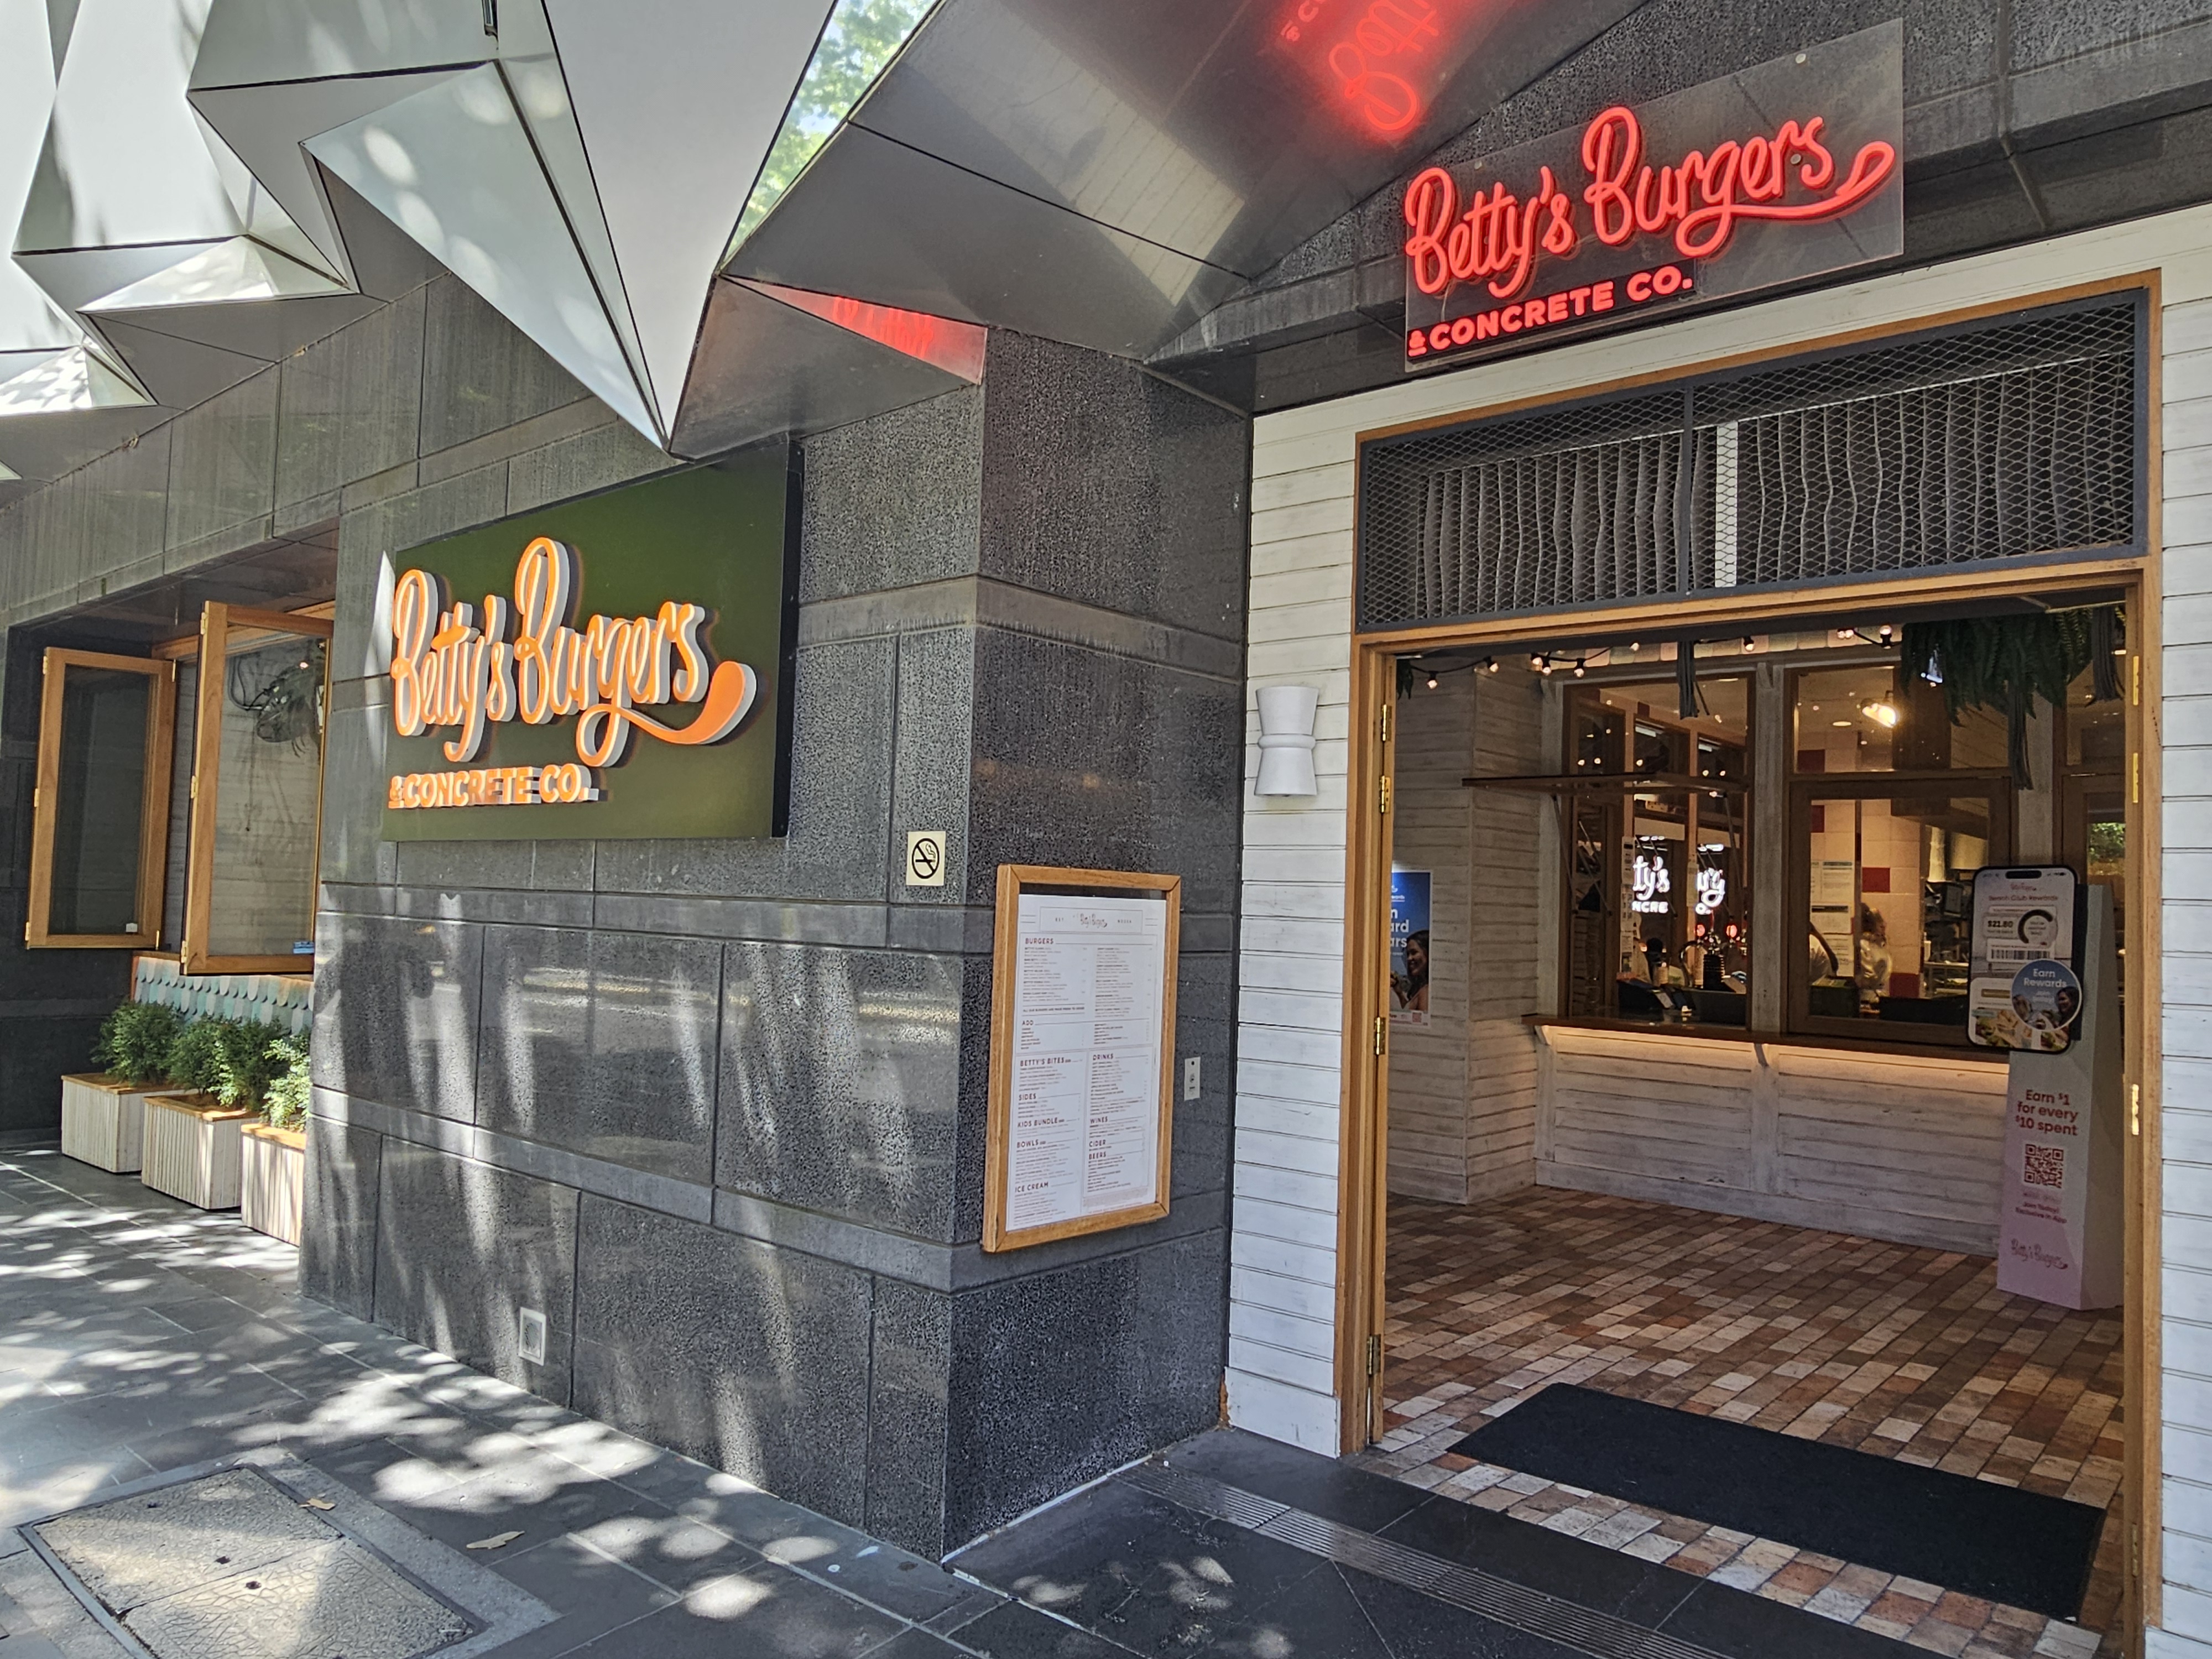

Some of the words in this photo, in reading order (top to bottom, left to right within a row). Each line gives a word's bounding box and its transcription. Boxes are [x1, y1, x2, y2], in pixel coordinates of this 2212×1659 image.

[1405, 166, 1575, 298] Betty's
[1582, 106, 1895, 257] Burgers
[1627, 265, 1693, 301] CO.
[391, 569, 515, 762] Betty's
[515, 537, 757, 766] Burgers
[539, 763, 598, 802] CO.
[2033, 969, 2056, 978] Earn
[2024, 978, 2067, 988] Rewards
[1020, 1058, 1045, 1067] BETTY'S
[2026, 1089, 2055, 1103] Earn
[2058, 1092, 2070, 1105] $1
[2017, 1100, 2036, 1114] for
[2038, 1107, 2079, 1123] every
[1018, 1119, 1032, 1128] KIDS
[1034, 1117, 1058, 1126] BUNDLE
[2015, 1115, 2034, 1129] $10
[2037, 1121, 2078, 1136] spent
[1016, 1139, 1039, 1148] BOWLS
[1089, 1151, 1107, 1160] BEERS
[1027, 1182, 1048, 1191] CREAM
